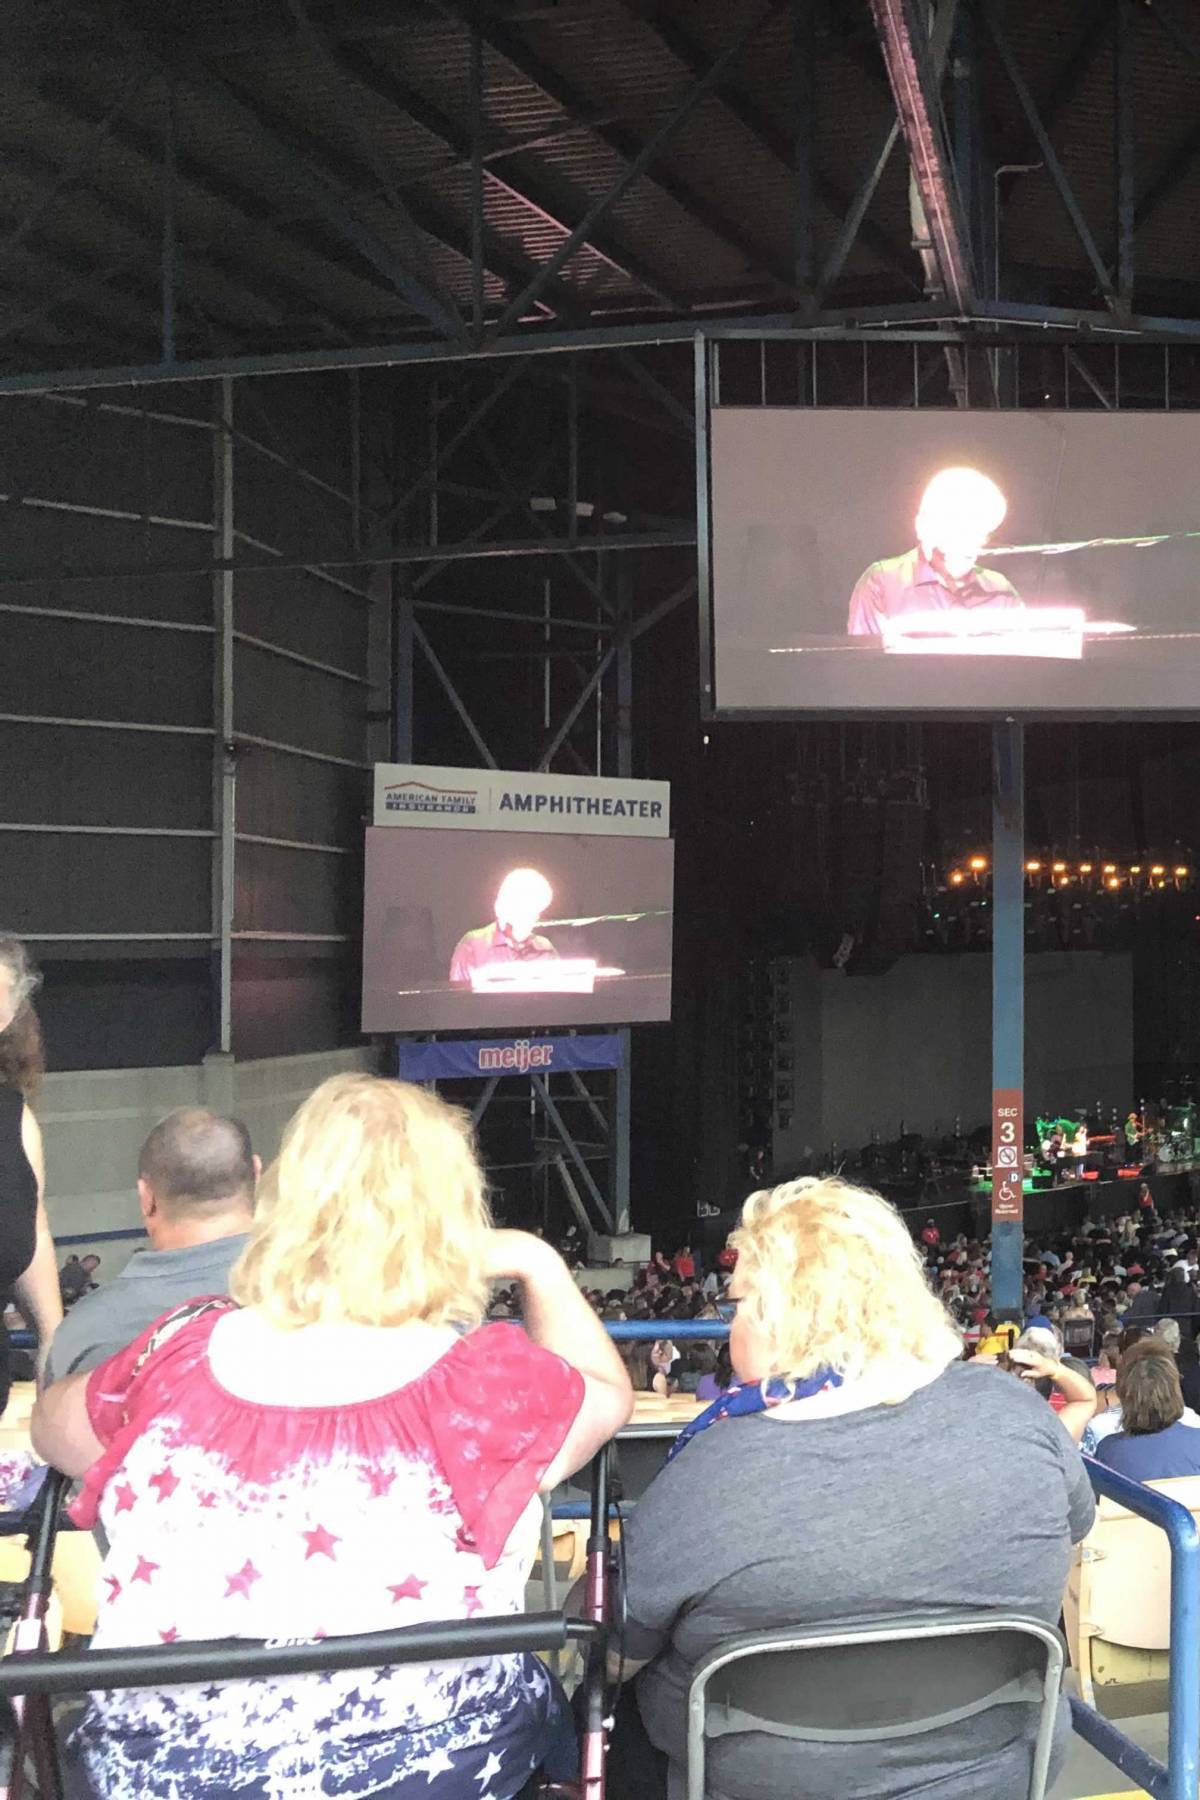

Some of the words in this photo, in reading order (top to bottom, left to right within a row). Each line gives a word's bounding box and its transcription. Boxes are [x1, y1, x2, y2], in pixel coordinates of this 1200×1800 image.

[499, 792, 662, 818] AMPHITHEATER
[478, 1040, 553, 1072] meijer
[998, 1108, 1018, 1117] SEC
[1000, 1121, 1015, 1143] 3
